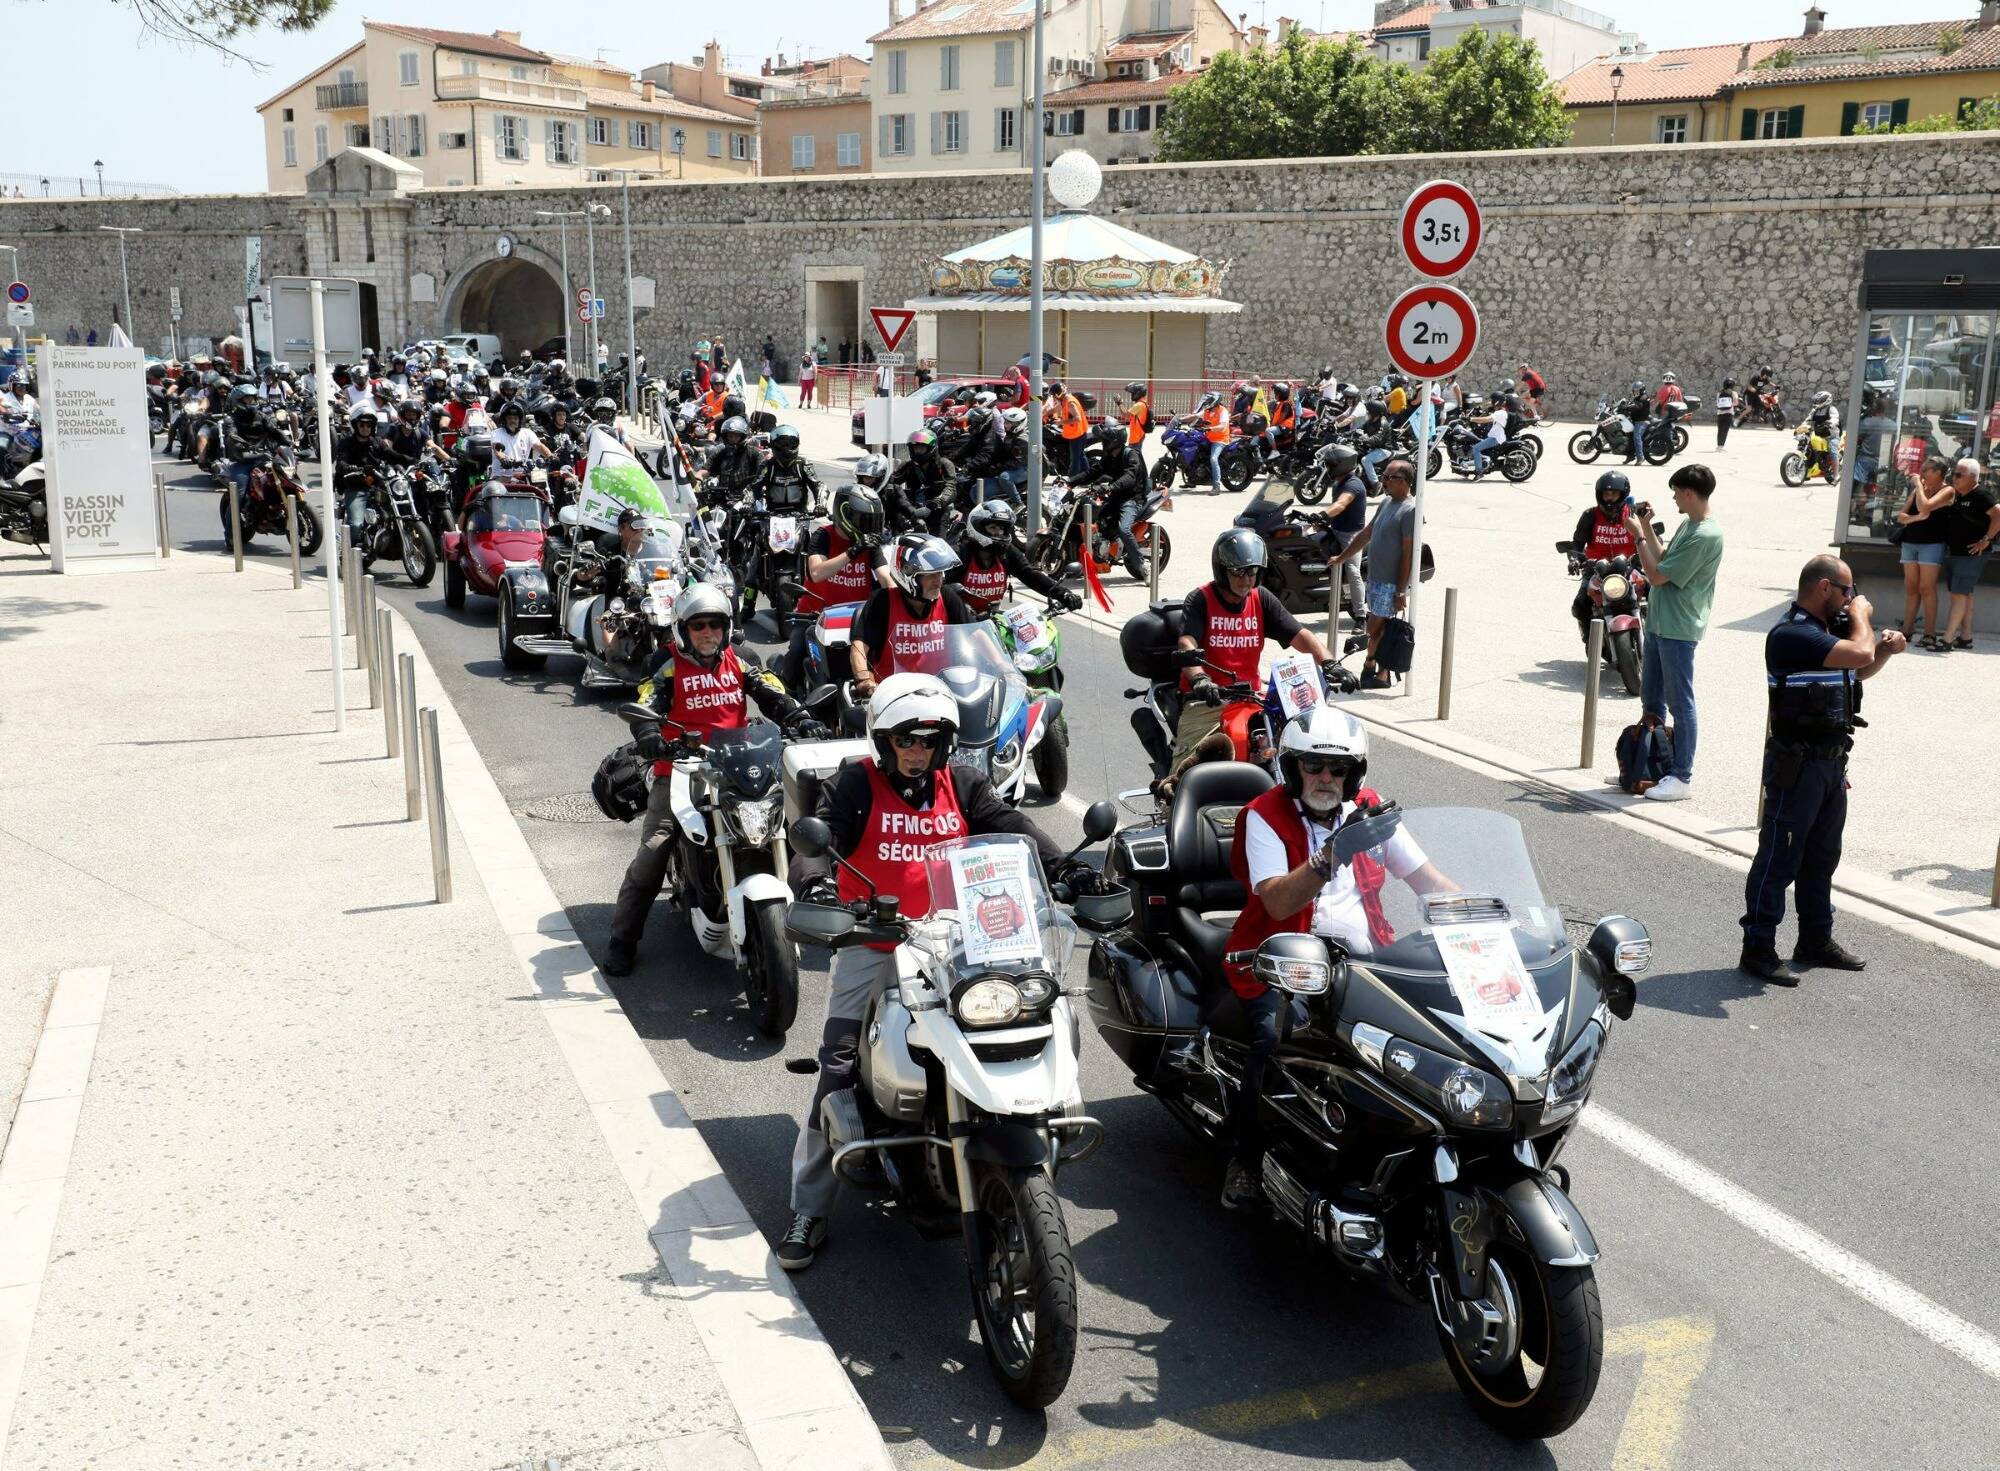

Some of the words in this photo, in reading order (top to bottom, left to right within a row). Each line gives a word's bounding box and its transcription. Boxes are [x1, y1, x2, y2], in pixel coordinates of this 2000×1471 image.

[53, 361, 95, 369] PARKING
[97, 361, 111, 369] DU
[113, 361, 137, 370] PORT
[55, 390, 96, 398] BASTION
[55, 399, 82, 407] SAINT
[85, 399, 116, 407] JAUME
[56, 409, 80, 417] QUAI
[57, 419, 118, 428] PROMENADE
[58, 427, 127, 436] PATRIMONIALE
[64, 495, 124, 510] BASSIN
[64, 509, 116, 524] VIEUX
[66, 524, 111, 539] PORT
[854, 562, 866, 574] 06
[967, 572, 992, 584] FFMC
[994, 571, 1005, 583] 06
[895, 623, 929, 637] FFMC
[930, 619, 945, 634] 06
[1211, 616, 1242, 631] FFMC
[1244, 616, 1258, 630] 06
[894, 636, 945, 654] SÉCURITÉ
[1209, 633, 1260, 648] SÉCURITÉ
[720, 670, 739, 688] 06
[881, 812, 933, 836] FFMC
[935, 811, 960, 836] 06
[982, 896, 1007, 910] FFMC
